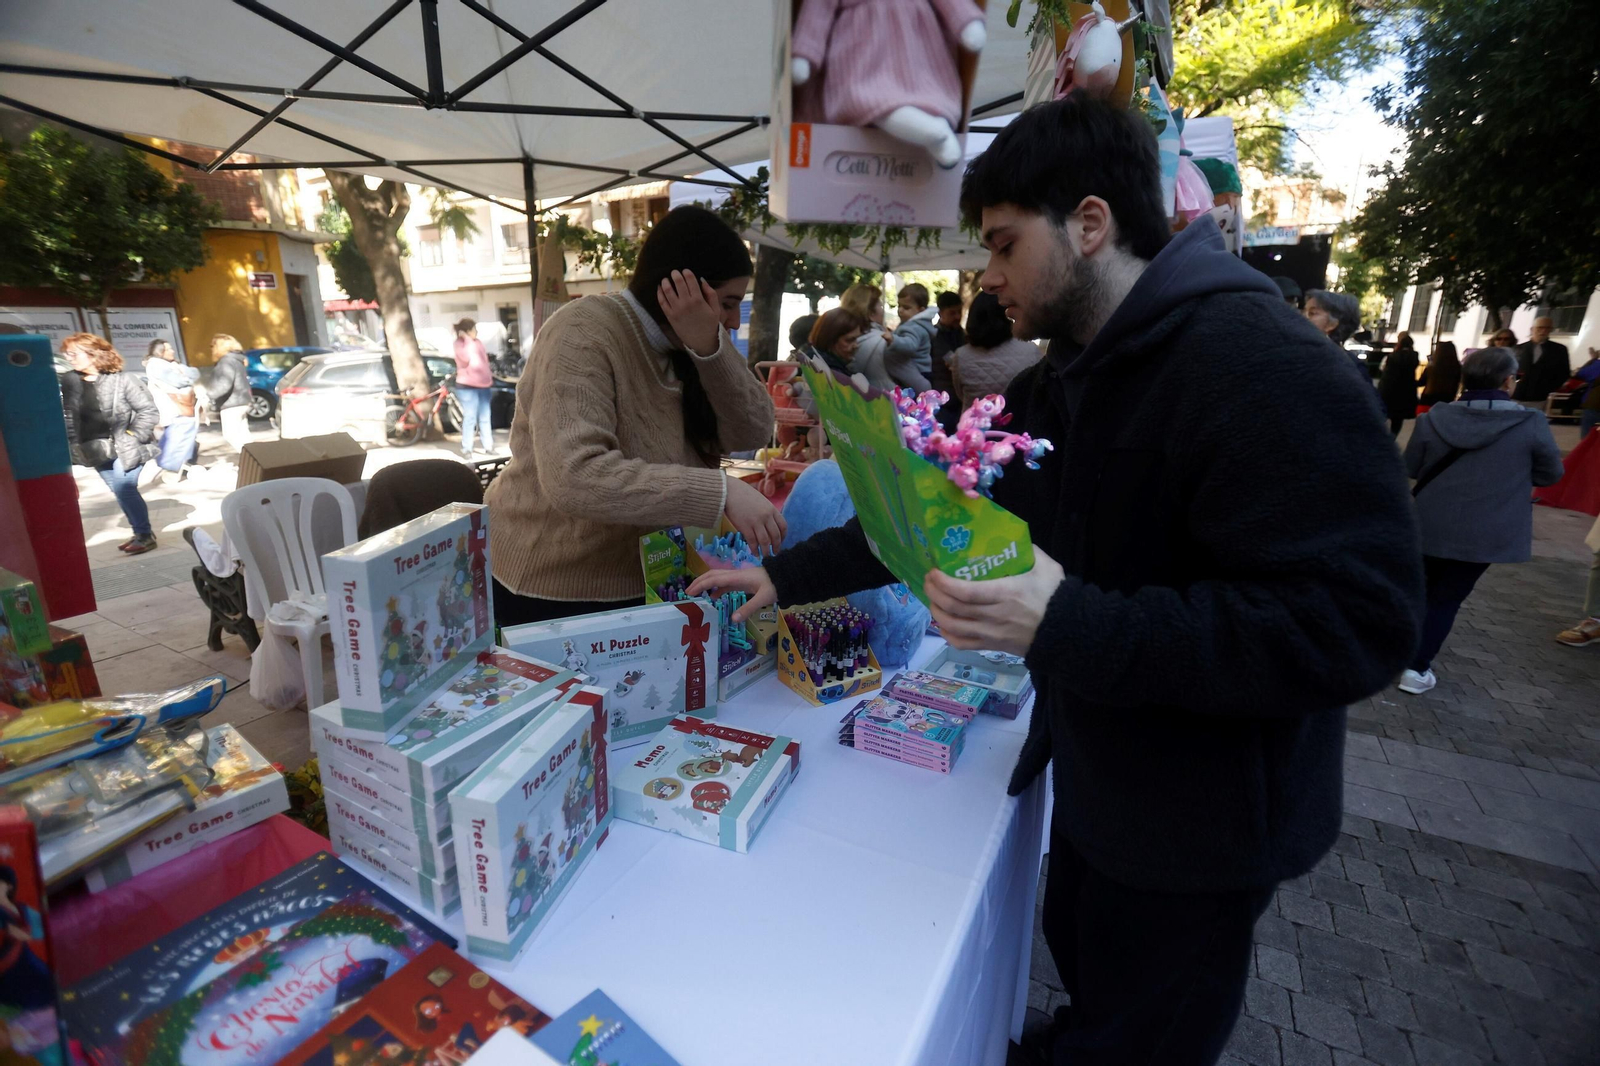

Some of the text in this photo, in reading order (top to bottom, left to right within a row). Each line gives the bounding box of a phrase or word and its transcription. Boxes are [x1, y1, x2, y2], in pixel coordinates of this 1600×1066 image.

[394, 537, 453, 575] Tree Game
[343, 581, 362, 697] Tree Game CHRISTMAS
[590, 635, 650, 654] XL Puzzle
[609, 650, 636, 659] CHRISTMAS
[745, 663, 761, 676] Memo
[322, 727, 344, 747] Tree
[346, 739, 374, 761] Game
[634, 745, 666, 769] Memo
[328, 764, 349, 784] Tree
[351, 777, 379, 799] Game
[522, 770, 547, 800] Tree
[549, 738, 577, 772] Game
[763, 785, 778, 809] Memo
[145, 798, 271, 851] Tree Game CHRISTMAS
[335, 802, 356, 822] Tree
[358, 816, 386, 838] Game
[339, 835, 359, 855] Tree
[361, 849, 387, 872] Game
[471, 818, 489, 927] Tree Game CHRISTMAS
